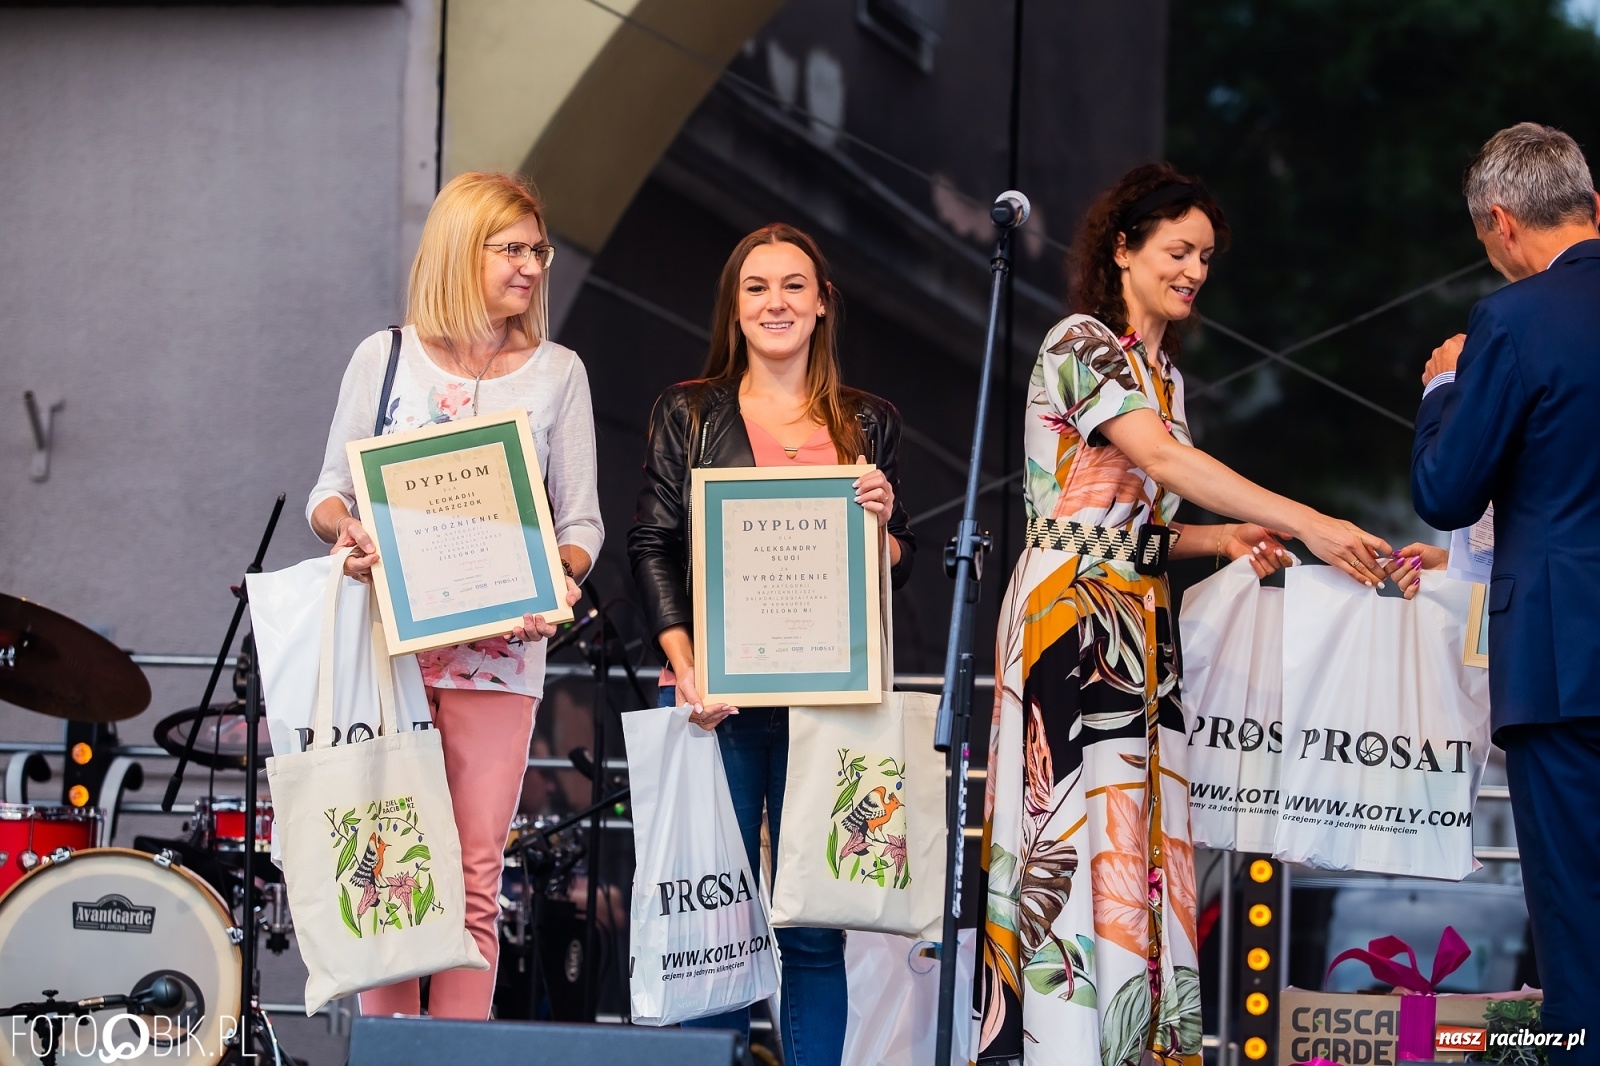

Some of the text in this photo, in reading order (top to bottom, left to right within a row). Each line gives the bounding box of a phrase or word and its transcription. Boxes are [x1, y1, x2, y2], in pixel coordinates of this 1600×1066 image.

[405, 465, 490, 490] DYPLOM
[429, 491, 475, 506] LEOKADII
[414, 513, 499, 535] WYRÓŻNIENIE
[742, 519, 827, 532] DYPLOM
[439, 549, 475, 561] ZIELONO
[742, 573, 828, 581] WYRÓŻNIENIE
[1188, 715, 1282, 753] PROS
[1299, 727, 1472, 774] PROSAT
[1284, 795, 1472, 828] WWW.KOTLY.COM
[1282, 813, 1418, 835] Grzejemy za jednym kliknięciem
[657, 869, 753, 916] PROSA
[76, 906, 152, 926] AvantGarde
[1291, 1006, 1400, 1036] CASCA
[1291, 1037, 1399, 1065] GARDE
